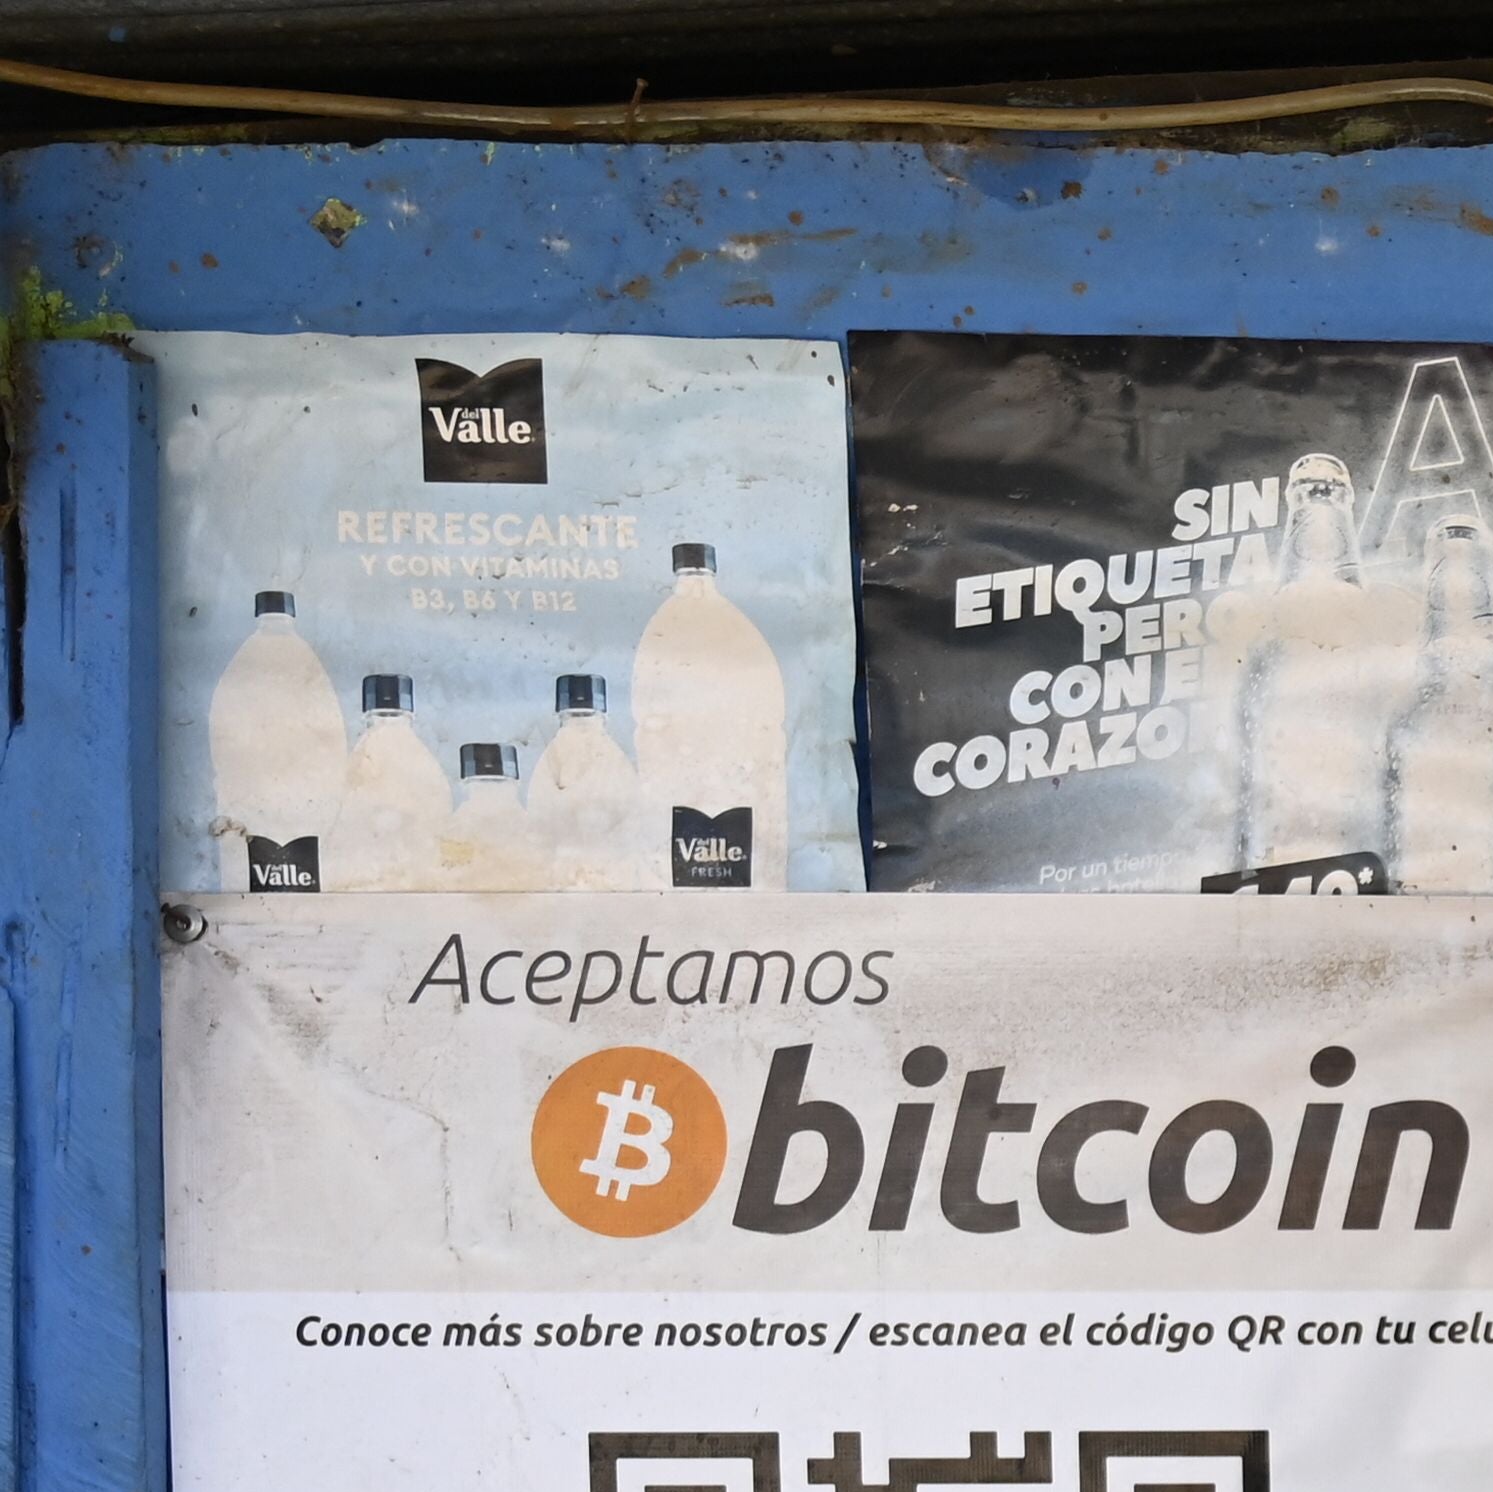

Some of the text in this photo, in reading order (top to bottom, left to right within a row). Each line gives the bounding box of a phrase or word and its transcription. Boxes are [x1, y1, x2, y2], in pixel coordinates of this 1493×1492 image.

[428, 406, 532, 444] Valle
[1172, 476, 1281, 541] SIN
[337, 510, 640, 549] REFRESCANTE
[361, 554, 621, 580] Y CON VITAMINAS
[955, 532, 1275, 628] ETIQUETA
[462, 588, 497, 611] B6
[504, 590, 521, 610] Y
[531, 590, 577, 612] B12
[1009, 654, 1151, 725] CON
[675, 837, 743, 863] Valle
[252, 863, 313, 887] Valle
[691, 866, 732, 878] FRESH
[1040, 865, 1075, 885] Por
[1081, 861, 1107, 878] un
[409, 933, 894, 1022] Aceptamos
[732, 1043, 1470, 1235] bitcoin
[296, 1316, 430, 1348] Conoce
[443, 1314, 523, 1348] más
[533, 1314, 641, 1348] sobre
[654, 1316, 827, 1348] nosotros
[869, 1319, 1027, 1347] escanea
[1039, 1313, 1073, 1347] el
[1085, 1312, 1214, 1353] código
[1226, 1314, 1284, 1352] QR
[1297, 1319, 1364, 1347] con
[1376, 1317, 1415, 1346] tu
